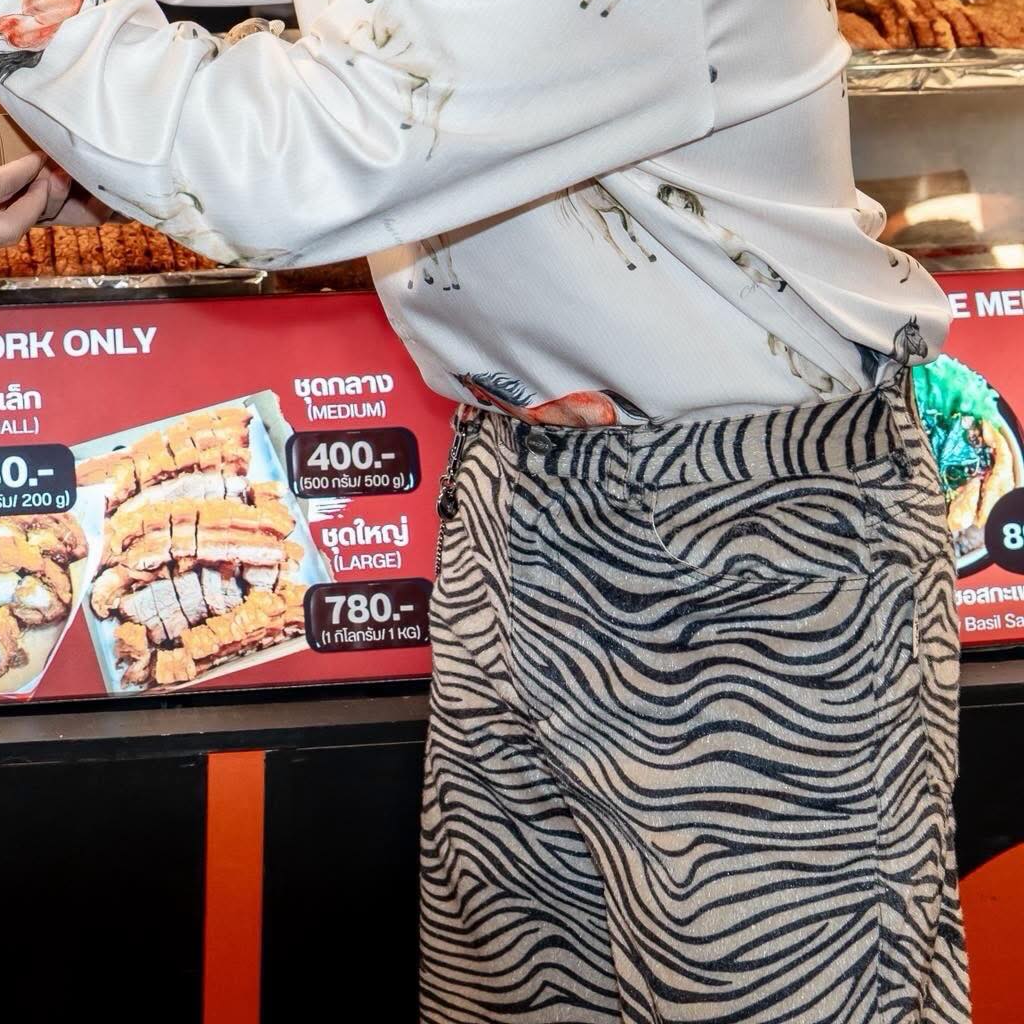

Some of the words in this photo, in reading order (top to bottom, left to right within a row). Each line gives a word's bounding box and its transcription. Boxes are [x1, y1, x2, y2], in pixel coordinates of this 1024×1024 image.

[974, 289, 1024, 318] ME
[63, 327, 157, 357] ONLY
[294, 374, 394, 405] ชุดกลาง
[307, 400, 387, 421] (MEDIUM)
[307, 440, 395, 471] 400.-
[299, 476, 329, 491] (500
[364, 474, 390, 487] 500
[392, 472, 405, 489] g)
[22, 492, 52, 507] 200
[55, 490, 70, 509] g)
[322, 515, 409, 555] ชุดใหญ่
[1002, 522, 1024, 551] 8
[334, 550, 402, 572] (LARGE)
[324, 592, 414, 625] 780.-
[964, 614, 1001, 632] Basil
[321, 630, 332, 645] (1
[388, 628, 395, 640] 1
[397, 624, 421, 640] KG)
